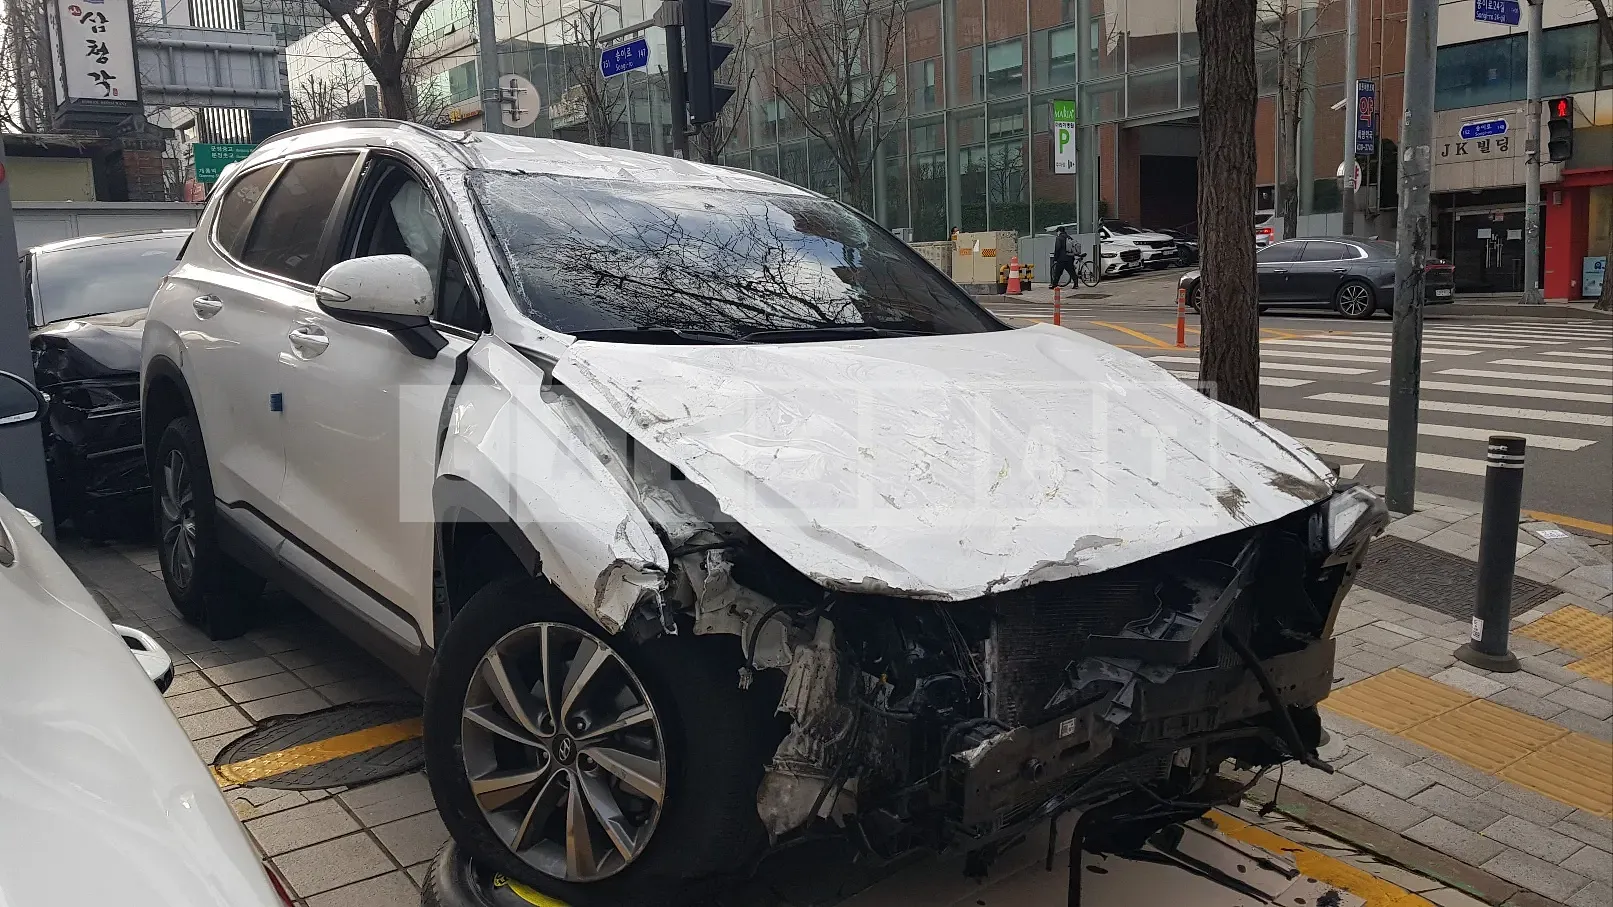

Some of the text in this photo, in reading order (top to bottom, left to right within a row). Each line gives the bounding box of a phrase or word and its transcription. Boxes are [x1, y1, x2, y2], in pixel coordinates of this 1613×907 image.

[80, 12, 116, 97] 삼청각
[615, 46, 633, 62] 송이로
[1359, 96, 1374, 128] 약
[1059, 128, 1070, 155] P
[1441, 136, 1509, 158] JK 빌딩
